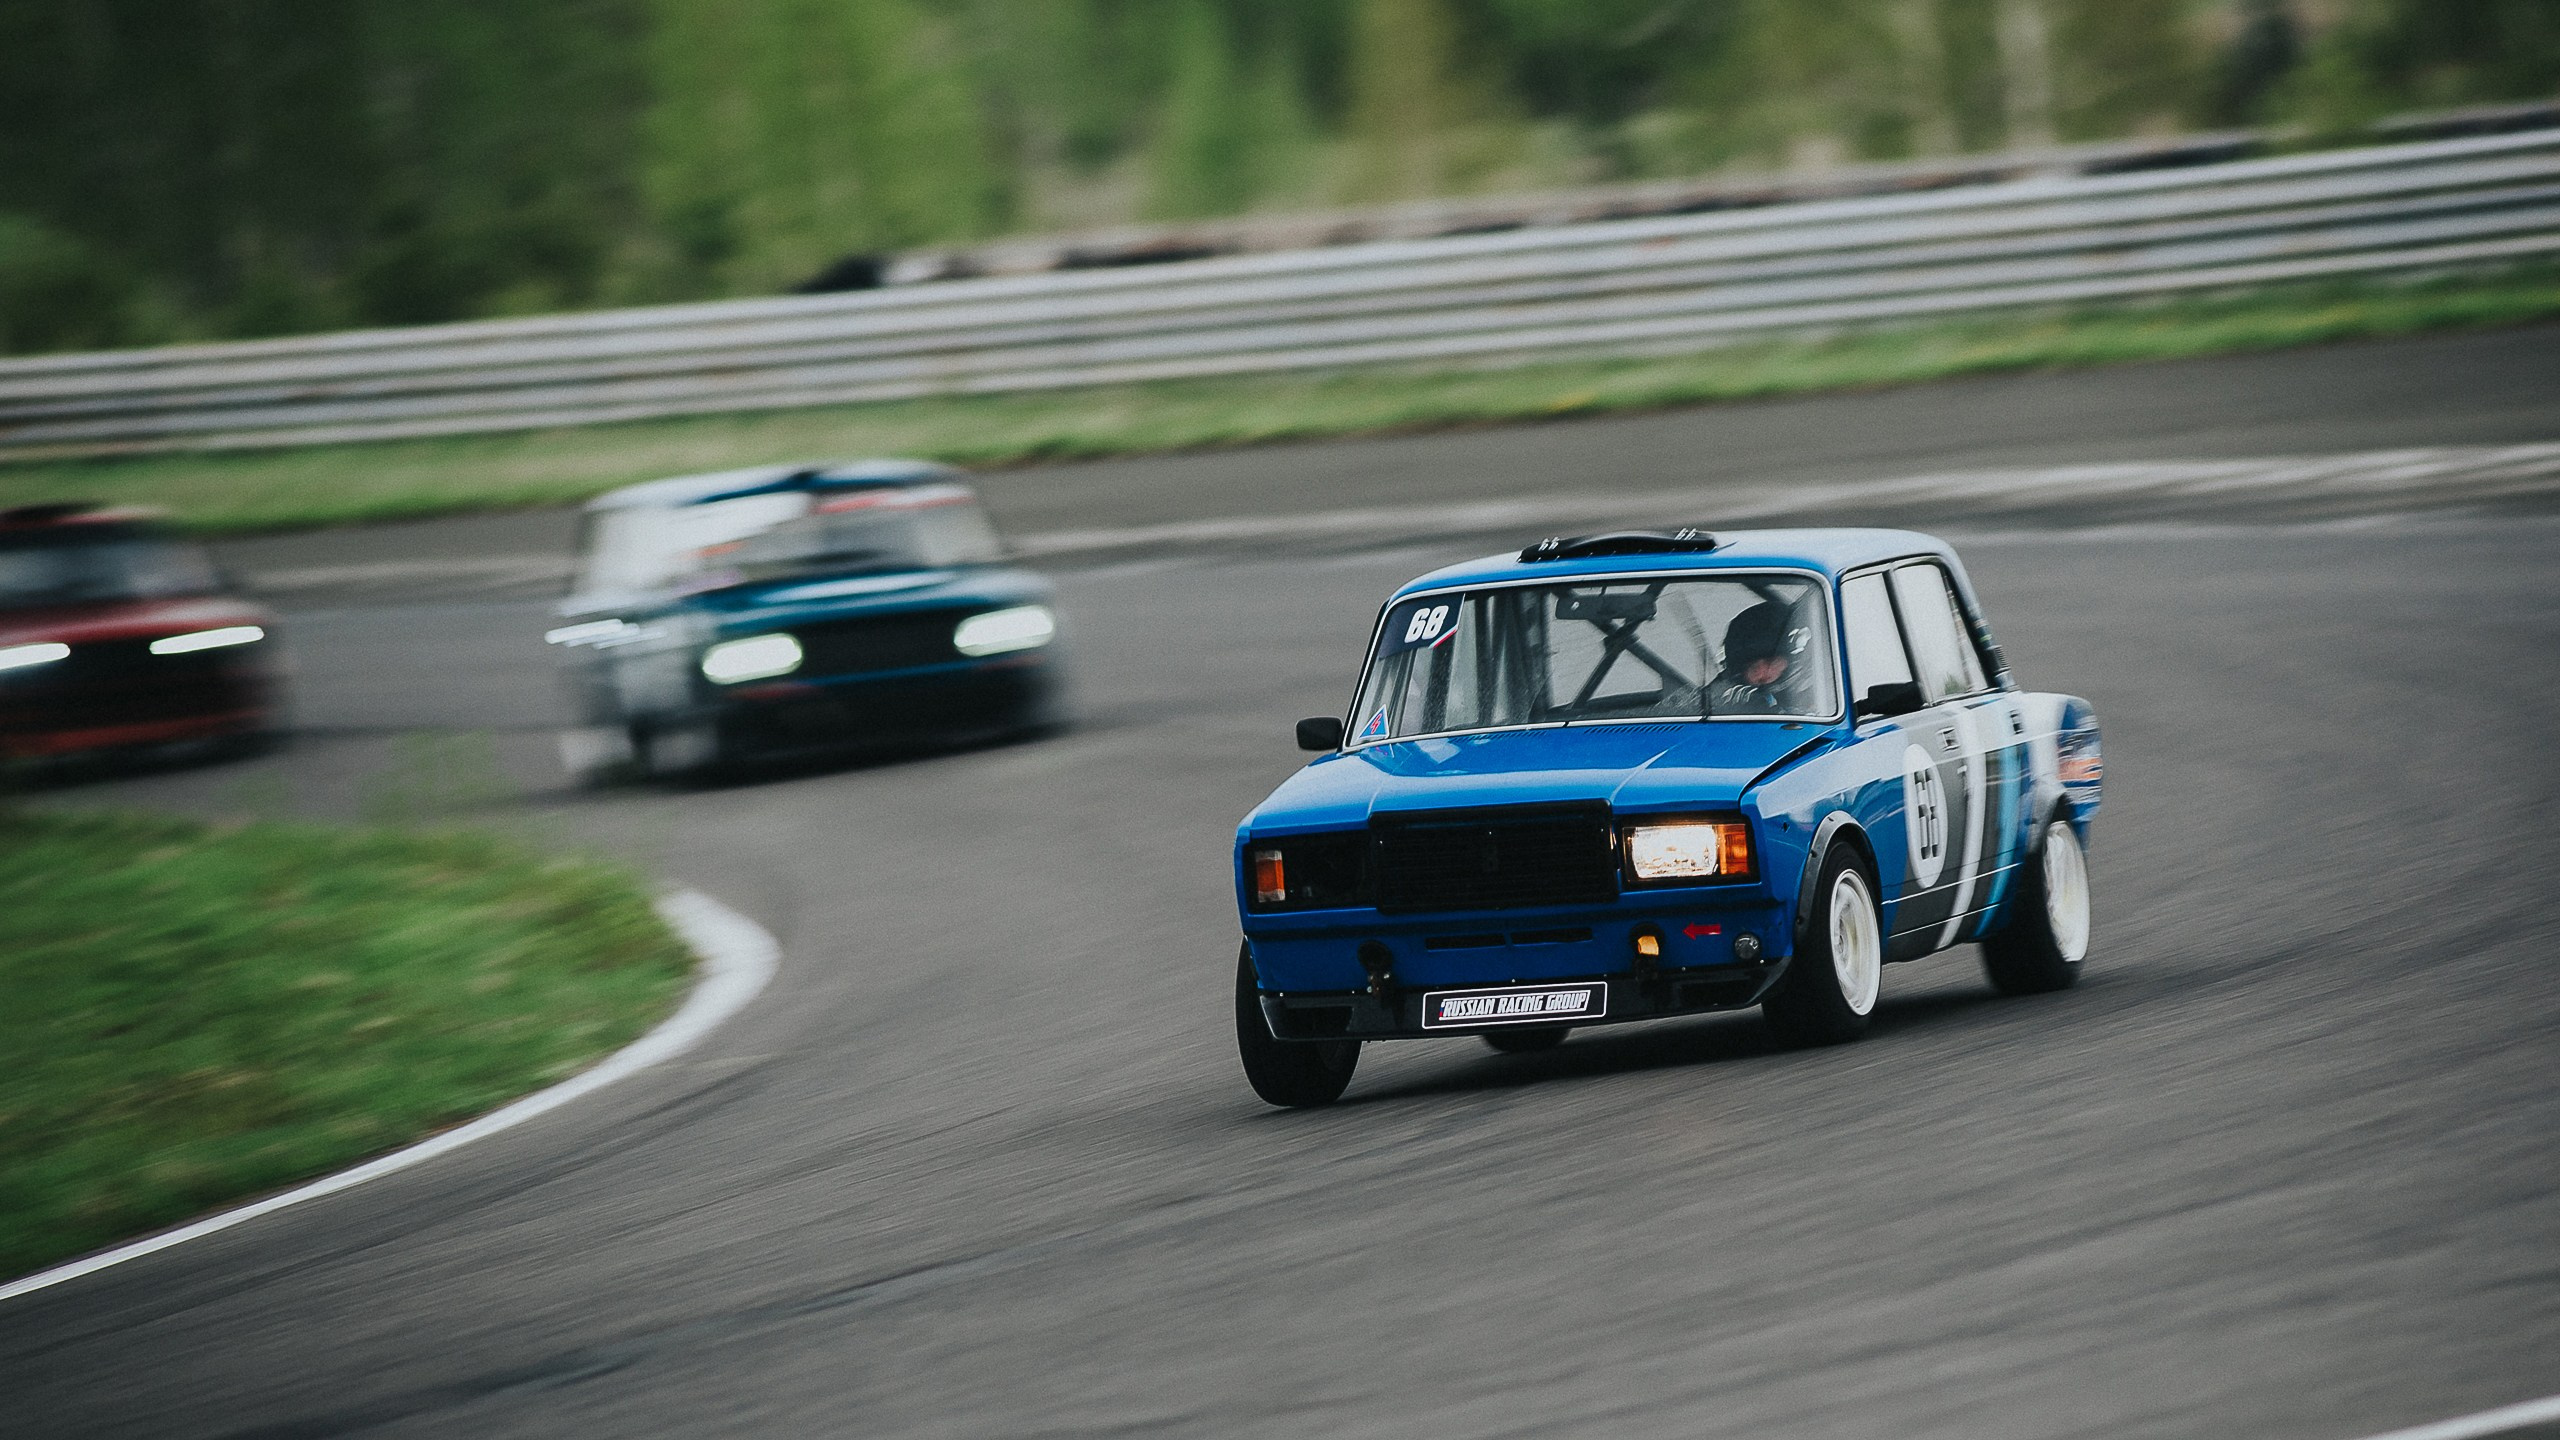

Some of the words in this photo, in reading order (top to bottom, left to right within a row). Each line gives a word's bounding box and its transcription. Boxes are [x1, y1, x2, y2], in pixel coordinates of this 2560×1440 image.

[1404, 605, 1449, 643] 68
[1914, 767, 1940, 860] 68
[1442, 998, 1496, 1017] RUSSIAN
[1497, 995, 1543, 1014] RACING
[1545, 992, 1588, 1011] GROUP
